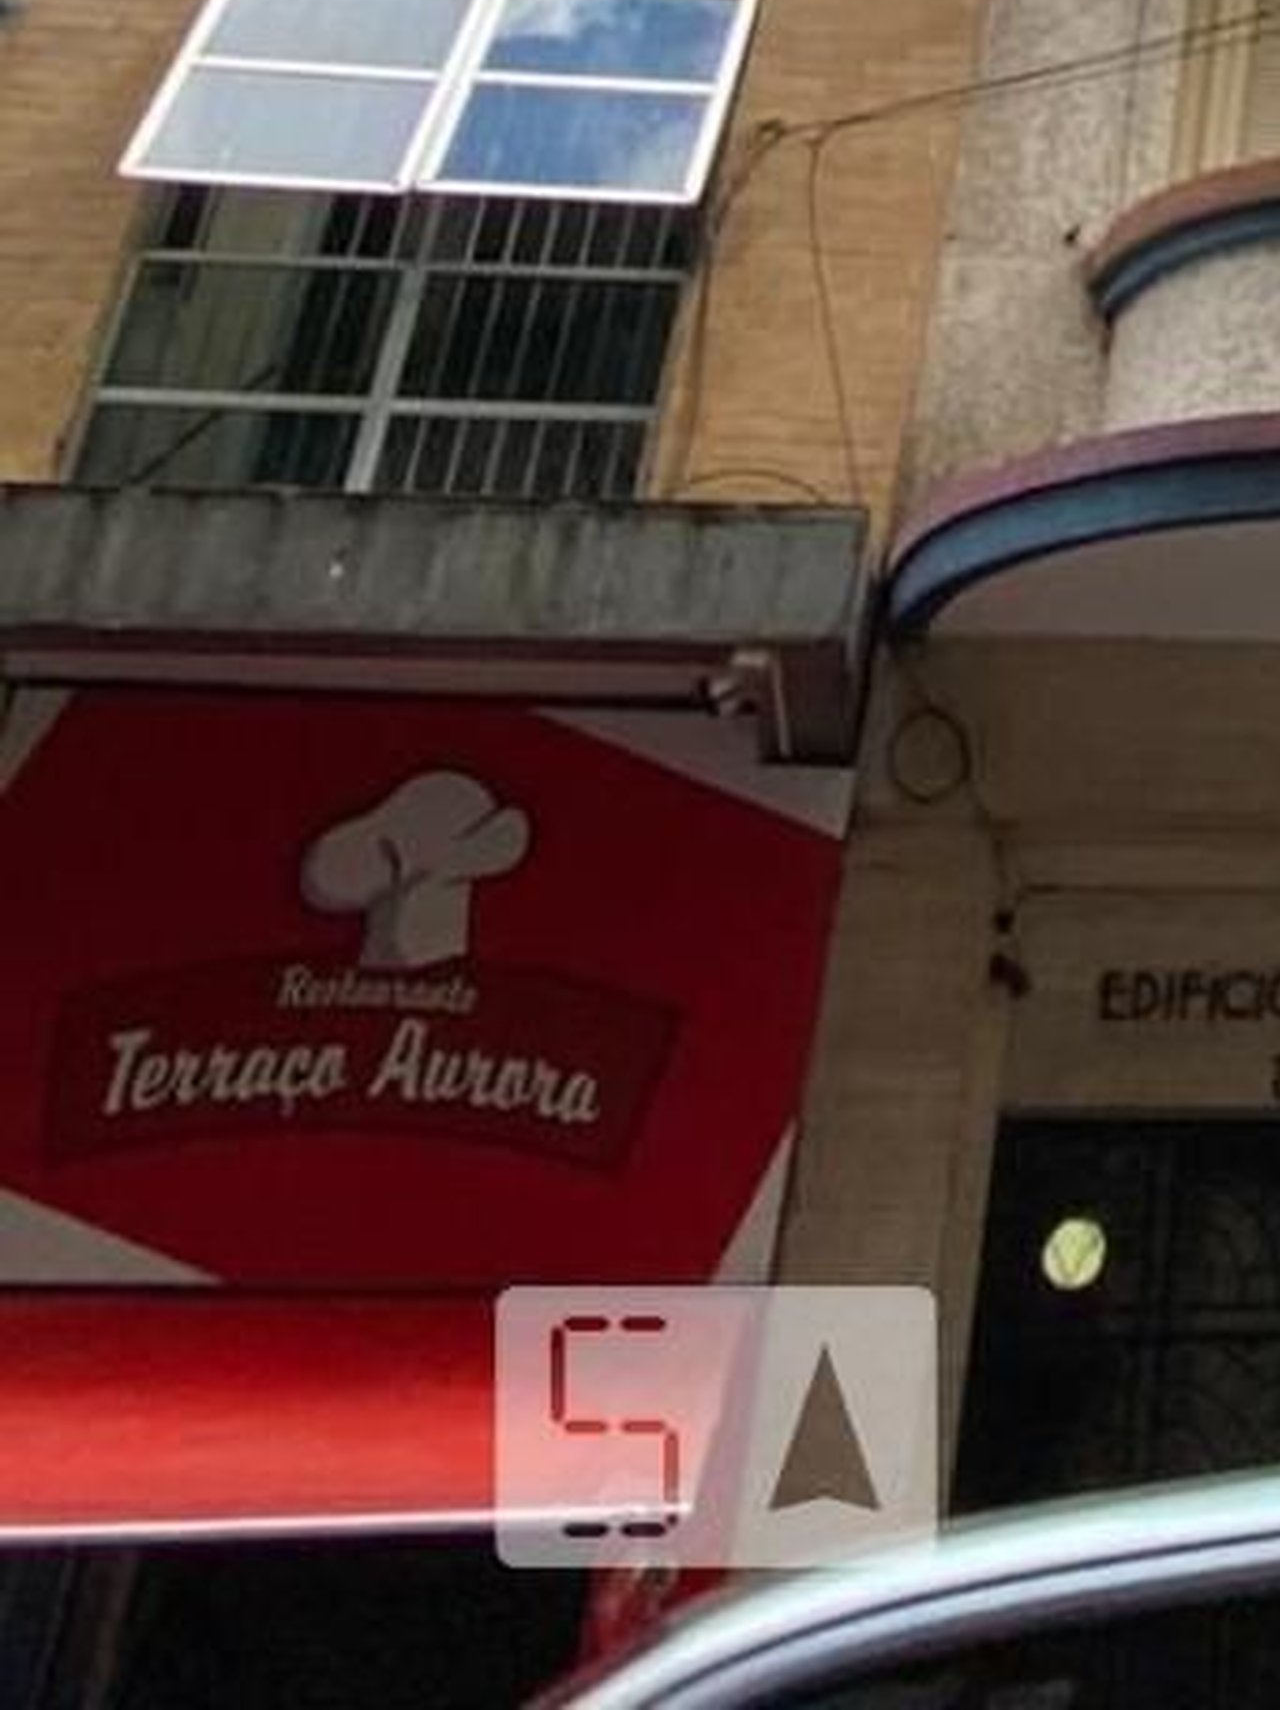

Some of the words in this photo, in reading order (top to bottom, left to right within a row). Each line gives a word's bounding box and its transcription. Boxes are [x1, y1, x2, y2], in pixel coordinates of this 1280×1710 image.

[276, 964, 480, 1012] Restaurante
[103, 1028, 348, 1118] Terraço
[367, 1016, 601, 1122] Aurora
